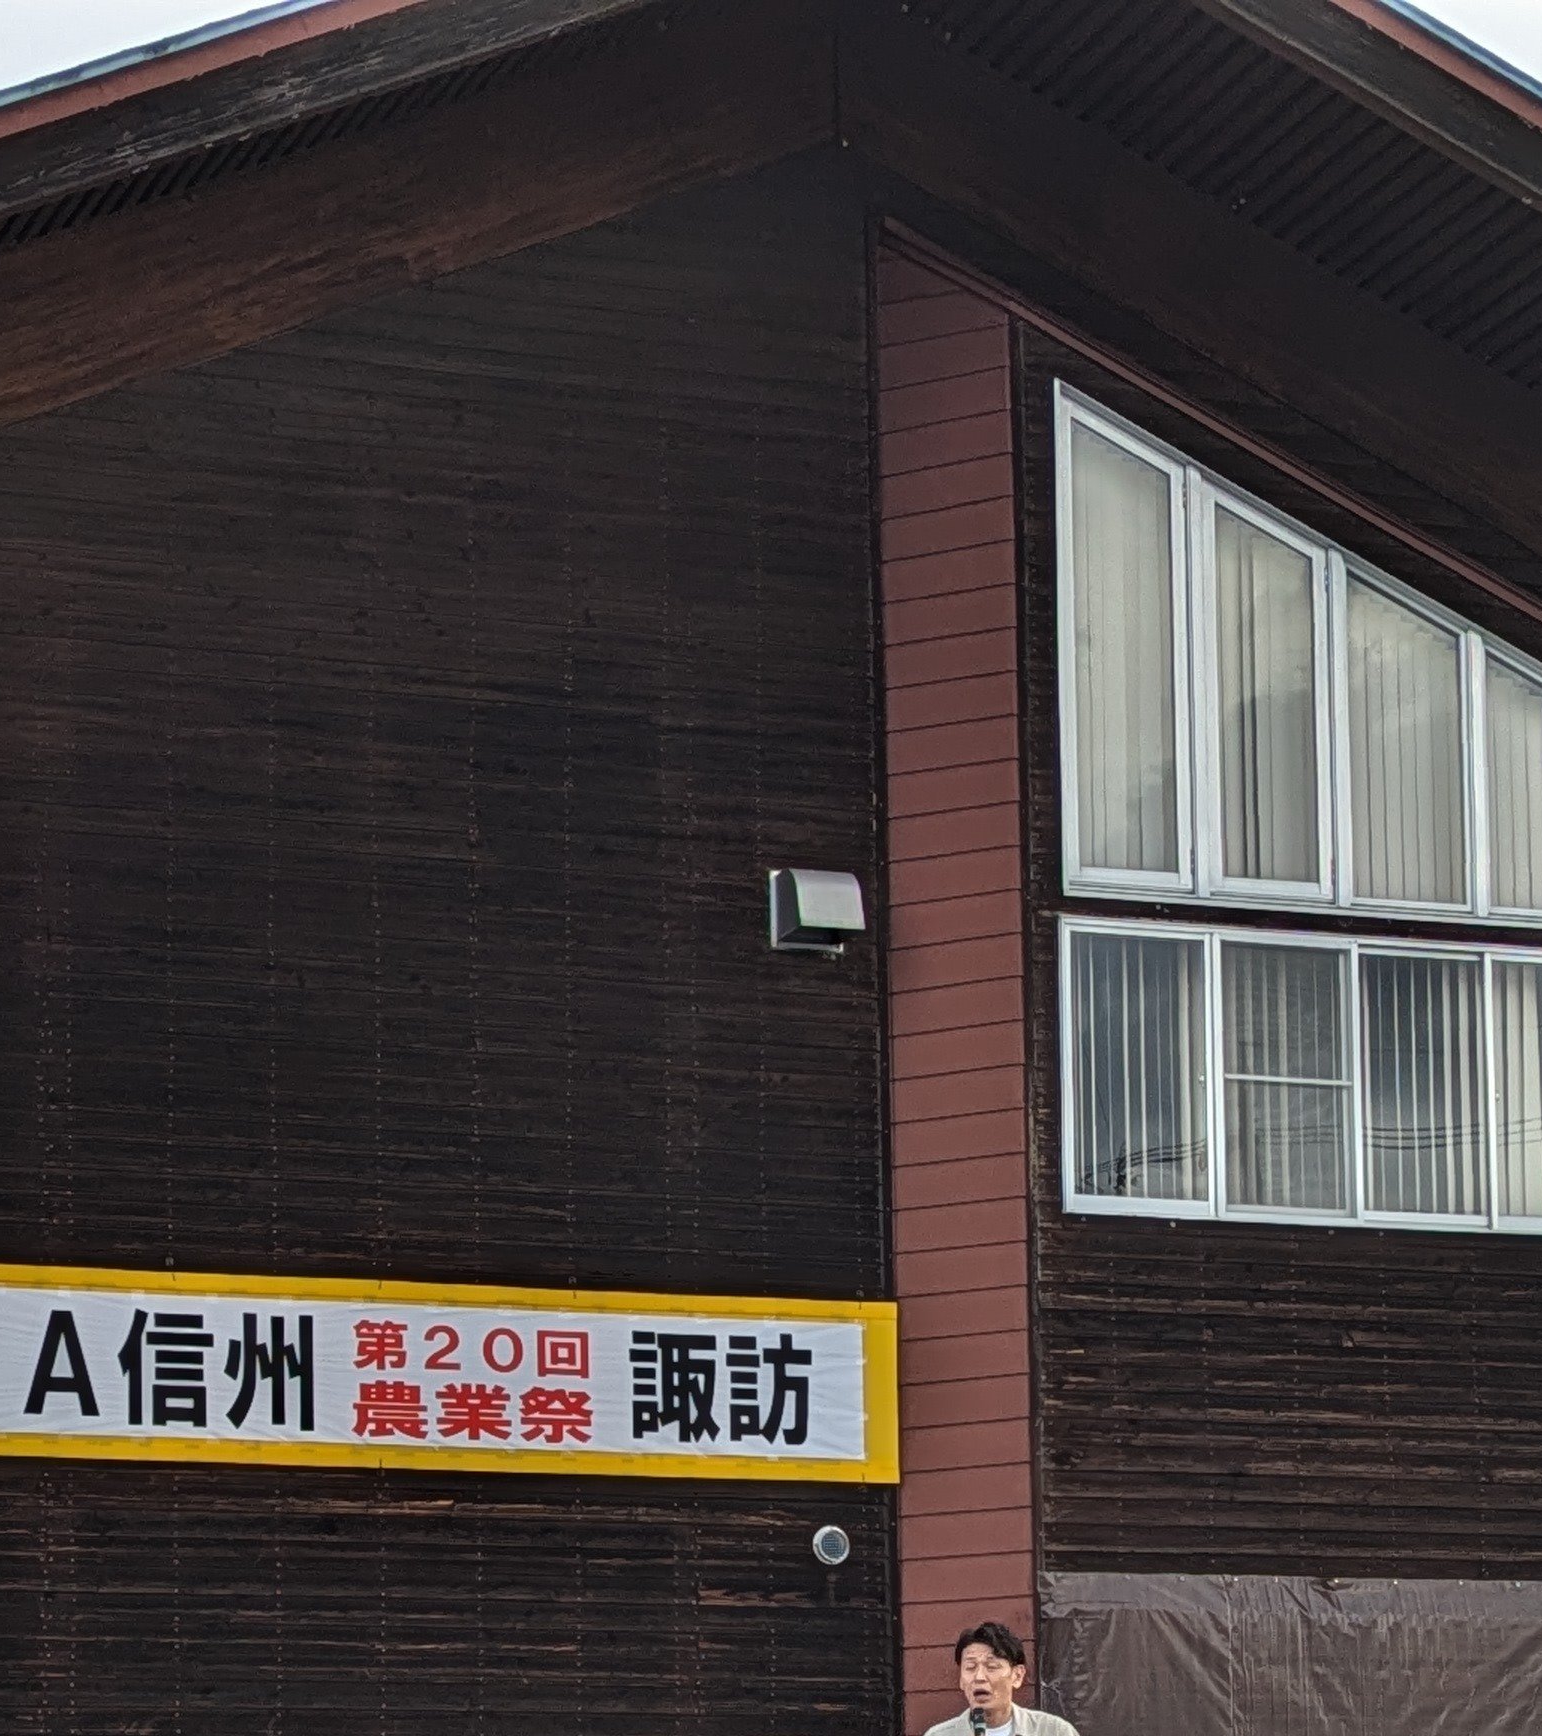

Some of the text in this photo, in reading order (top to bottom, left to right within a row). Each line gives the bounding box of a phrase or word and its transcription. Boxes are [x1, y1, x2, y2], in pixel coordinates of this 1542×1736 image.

[352, 1320, 593, 1378] 第20回
[351, 1381, 594, 1444] 農業祭
[628, 1330, 813, 1445] 諏訪
